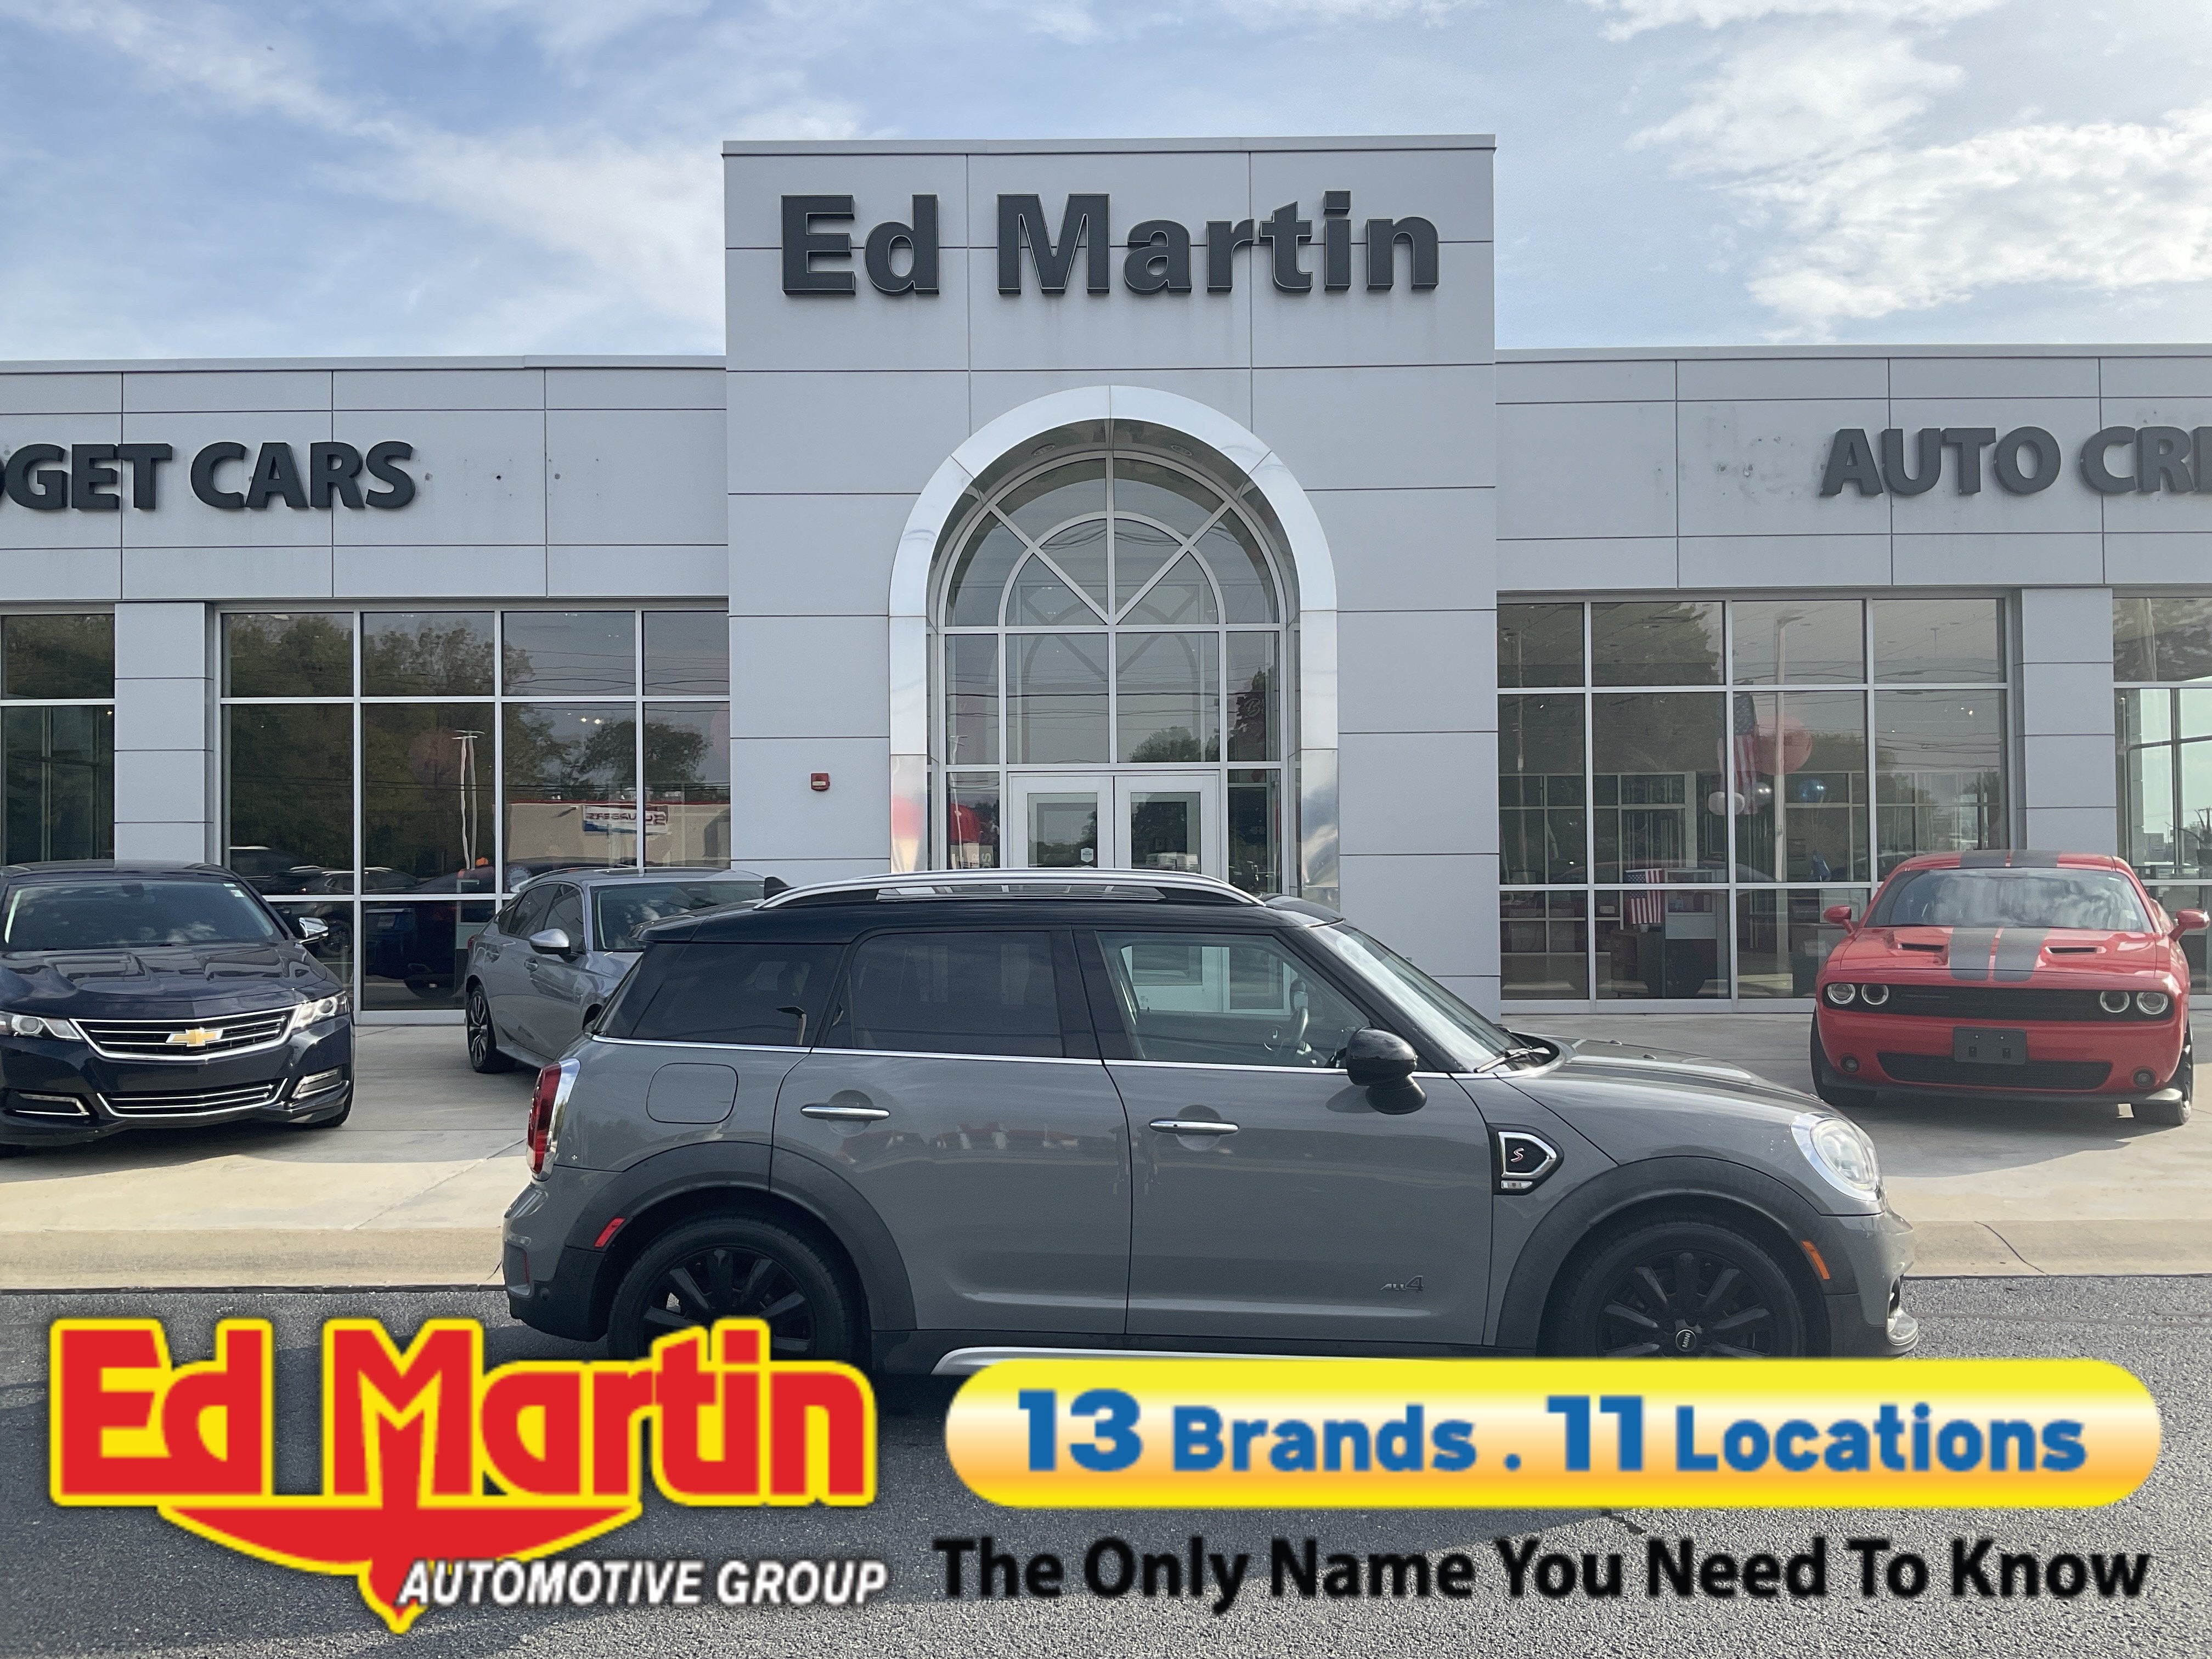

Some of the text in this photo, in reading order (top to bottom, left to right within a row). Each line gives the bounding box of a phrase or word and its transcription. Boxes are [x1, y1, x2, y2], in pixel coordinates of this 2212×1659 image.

[781, 190, 1439, 295] Ed Martin
[0, 441, 416, 511] GET CARS
[1819, 426, 2061, 495] AUTO
[1681, 1332, 1691, 1348] MINI
